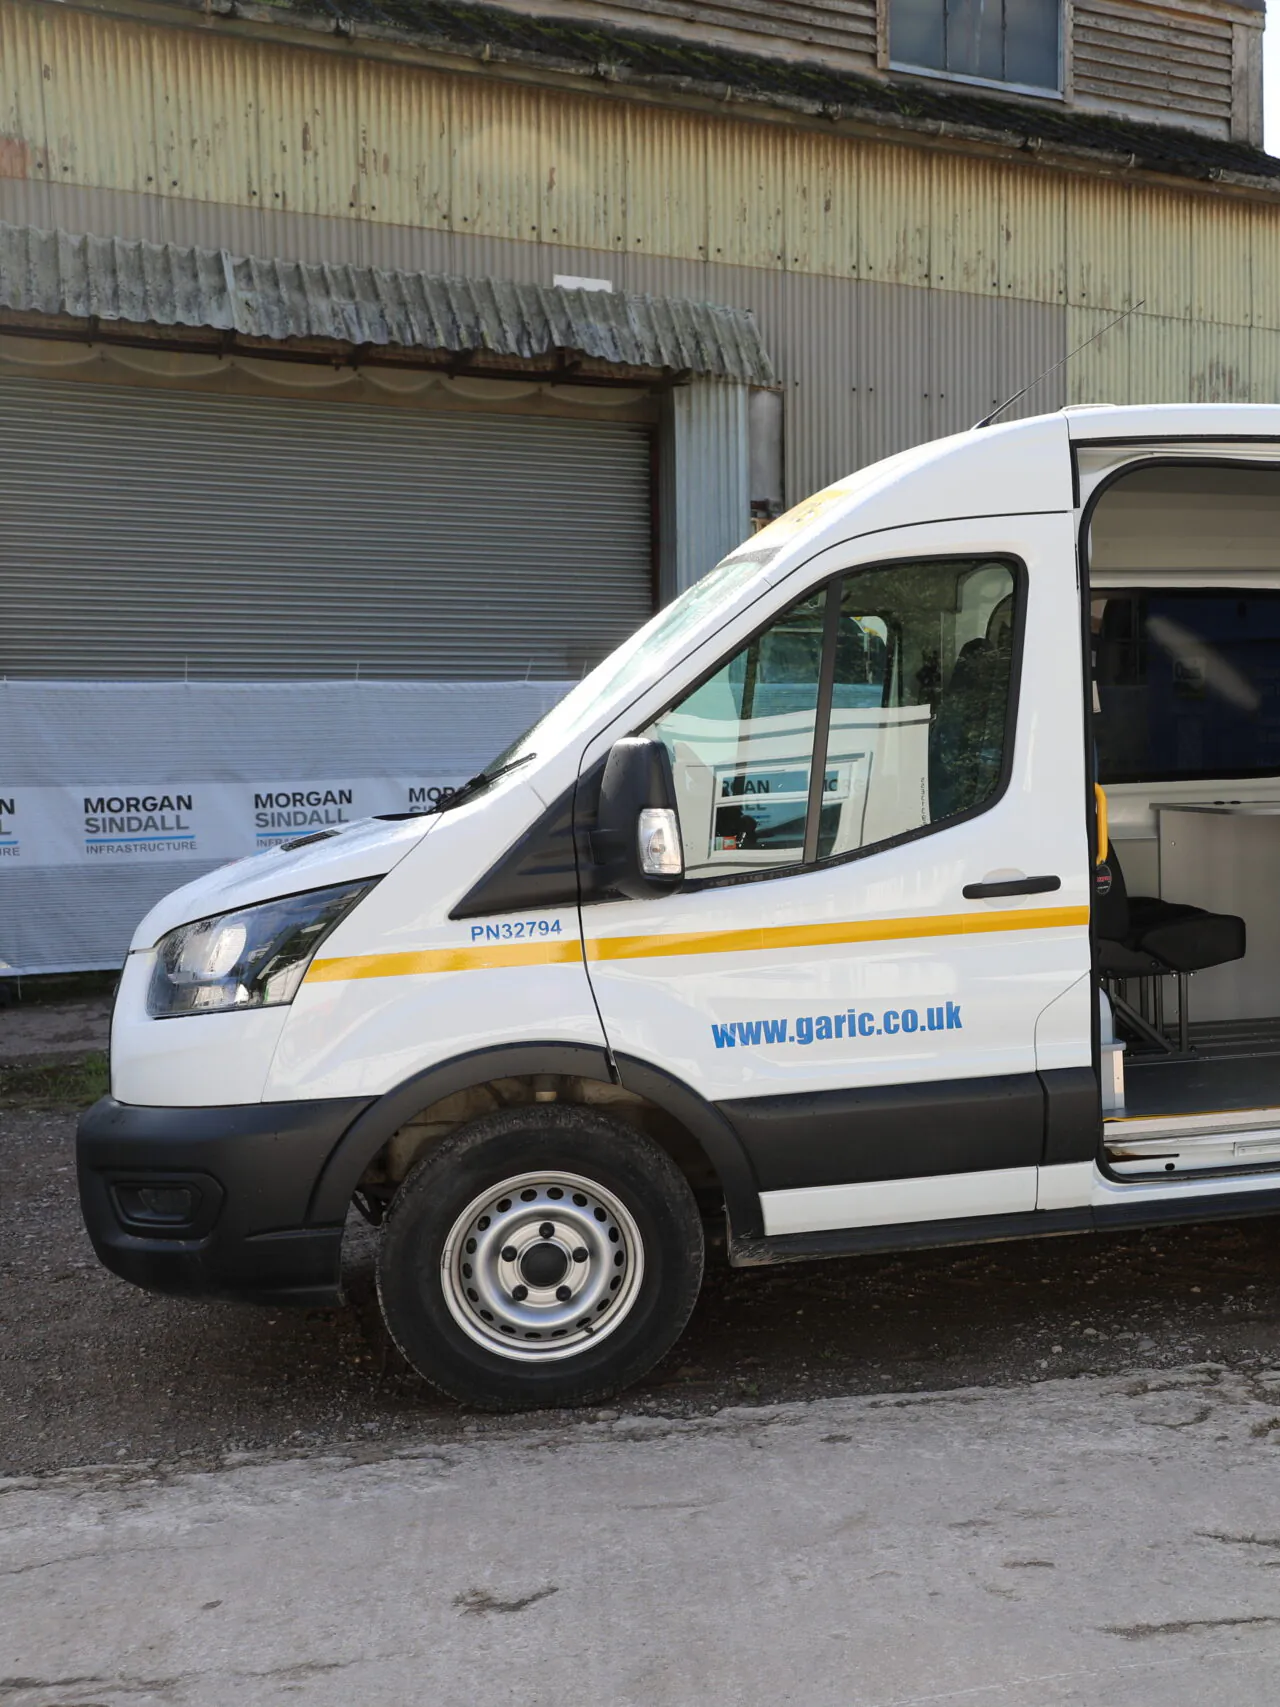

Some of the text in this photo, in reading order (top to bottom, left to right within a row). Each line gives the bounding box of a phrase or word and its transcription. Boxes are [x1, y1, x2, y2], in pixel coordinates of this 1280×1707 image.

[84, 795, 193, 814] MORGAN
[254, 789, 352, 809] MORGAN
[84, 815, 190, 834] SINDALL
[255, 809, 349, 828] SINDALL
[85, 841, 197, 854] INFRASTRUCTURE
[471, 919, 562, 942] PN32794
[711, 1001, 963, 1049] www.garic.co.uk
